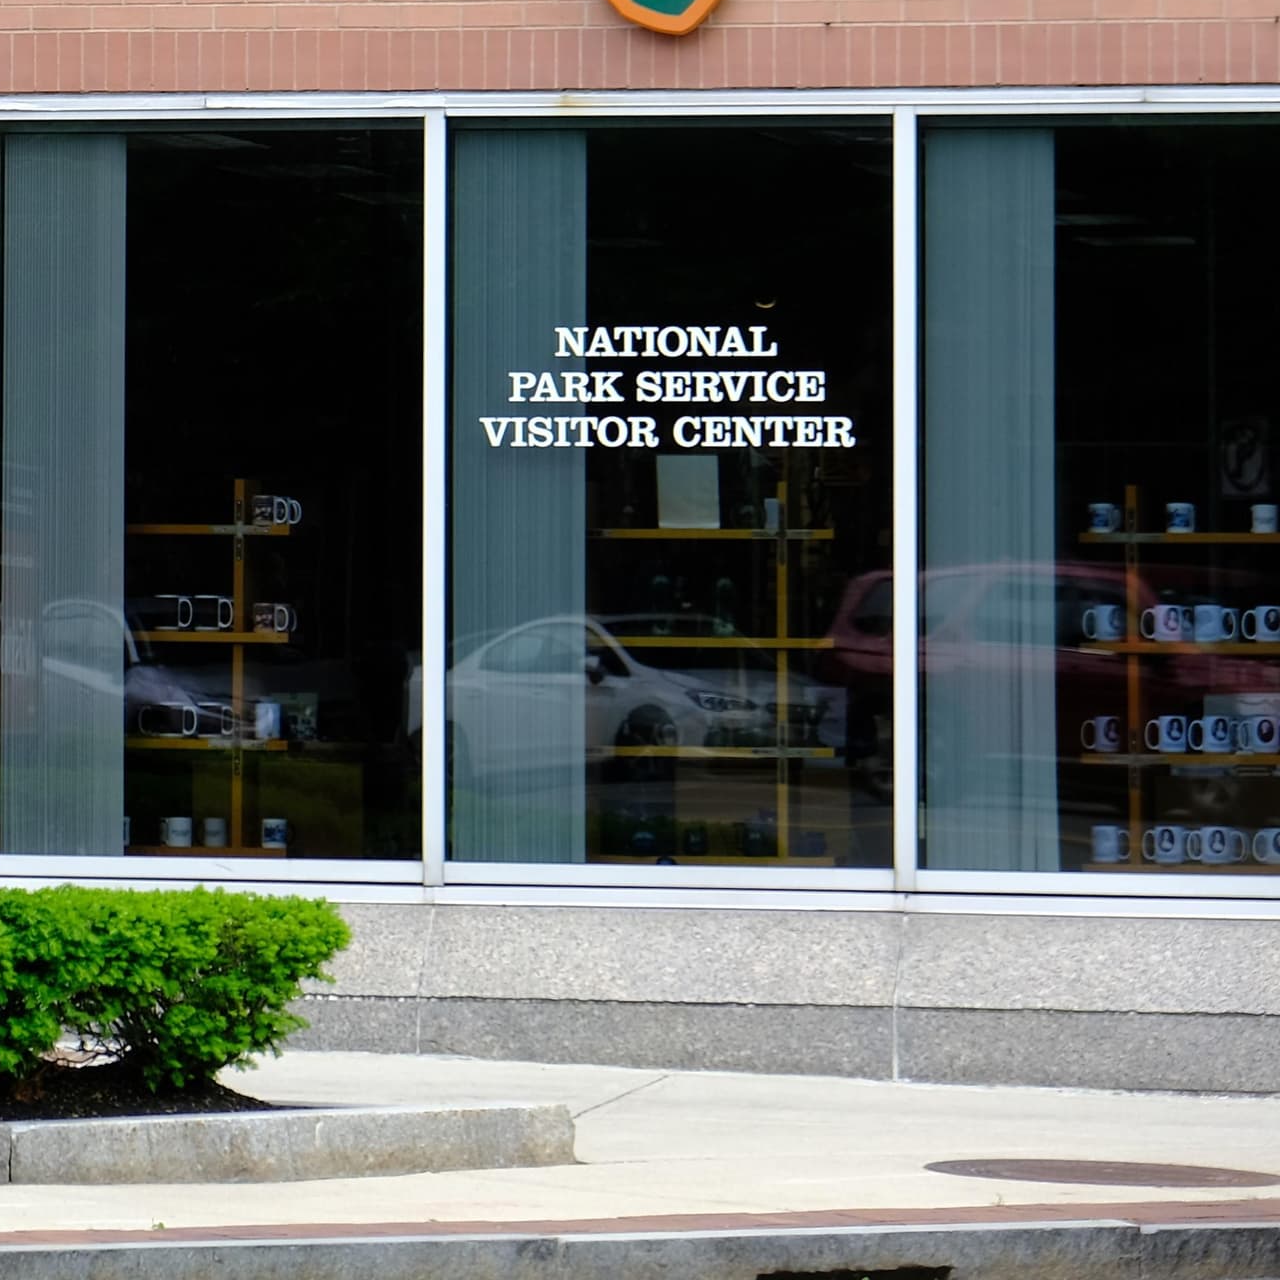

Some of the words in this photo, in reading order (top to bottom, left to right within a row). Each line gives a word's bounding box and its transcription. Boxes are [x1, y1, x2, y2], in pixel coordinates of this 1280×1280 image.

[554, 326, 778, 358] NATIONAL
[508, 371, 625, 403] PARK
[636, 370, 826, 403] SERVICE
[477, 416, 659, 448] VISITOR
[673, 416, 856, 448] CENTER
